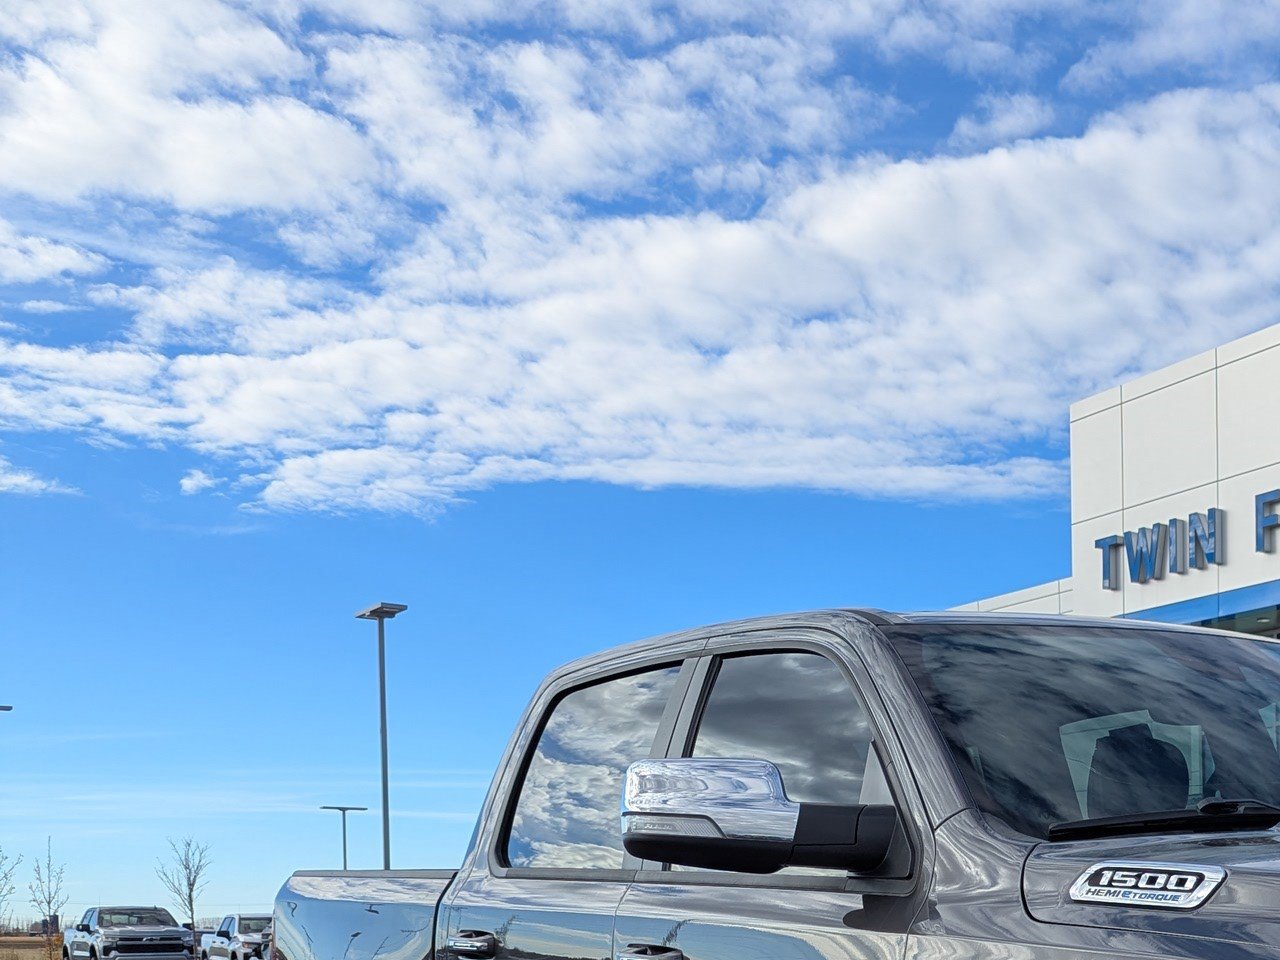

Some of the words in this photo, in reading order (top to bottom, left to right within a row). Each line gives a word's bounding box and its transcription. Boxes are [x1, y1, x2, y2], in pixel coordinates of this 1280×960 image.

[1095, 507, 1225, 592] TWIN
[1099, 871, 1198, 891] 1500
[1085, 888, 1121, 898] HEMI
